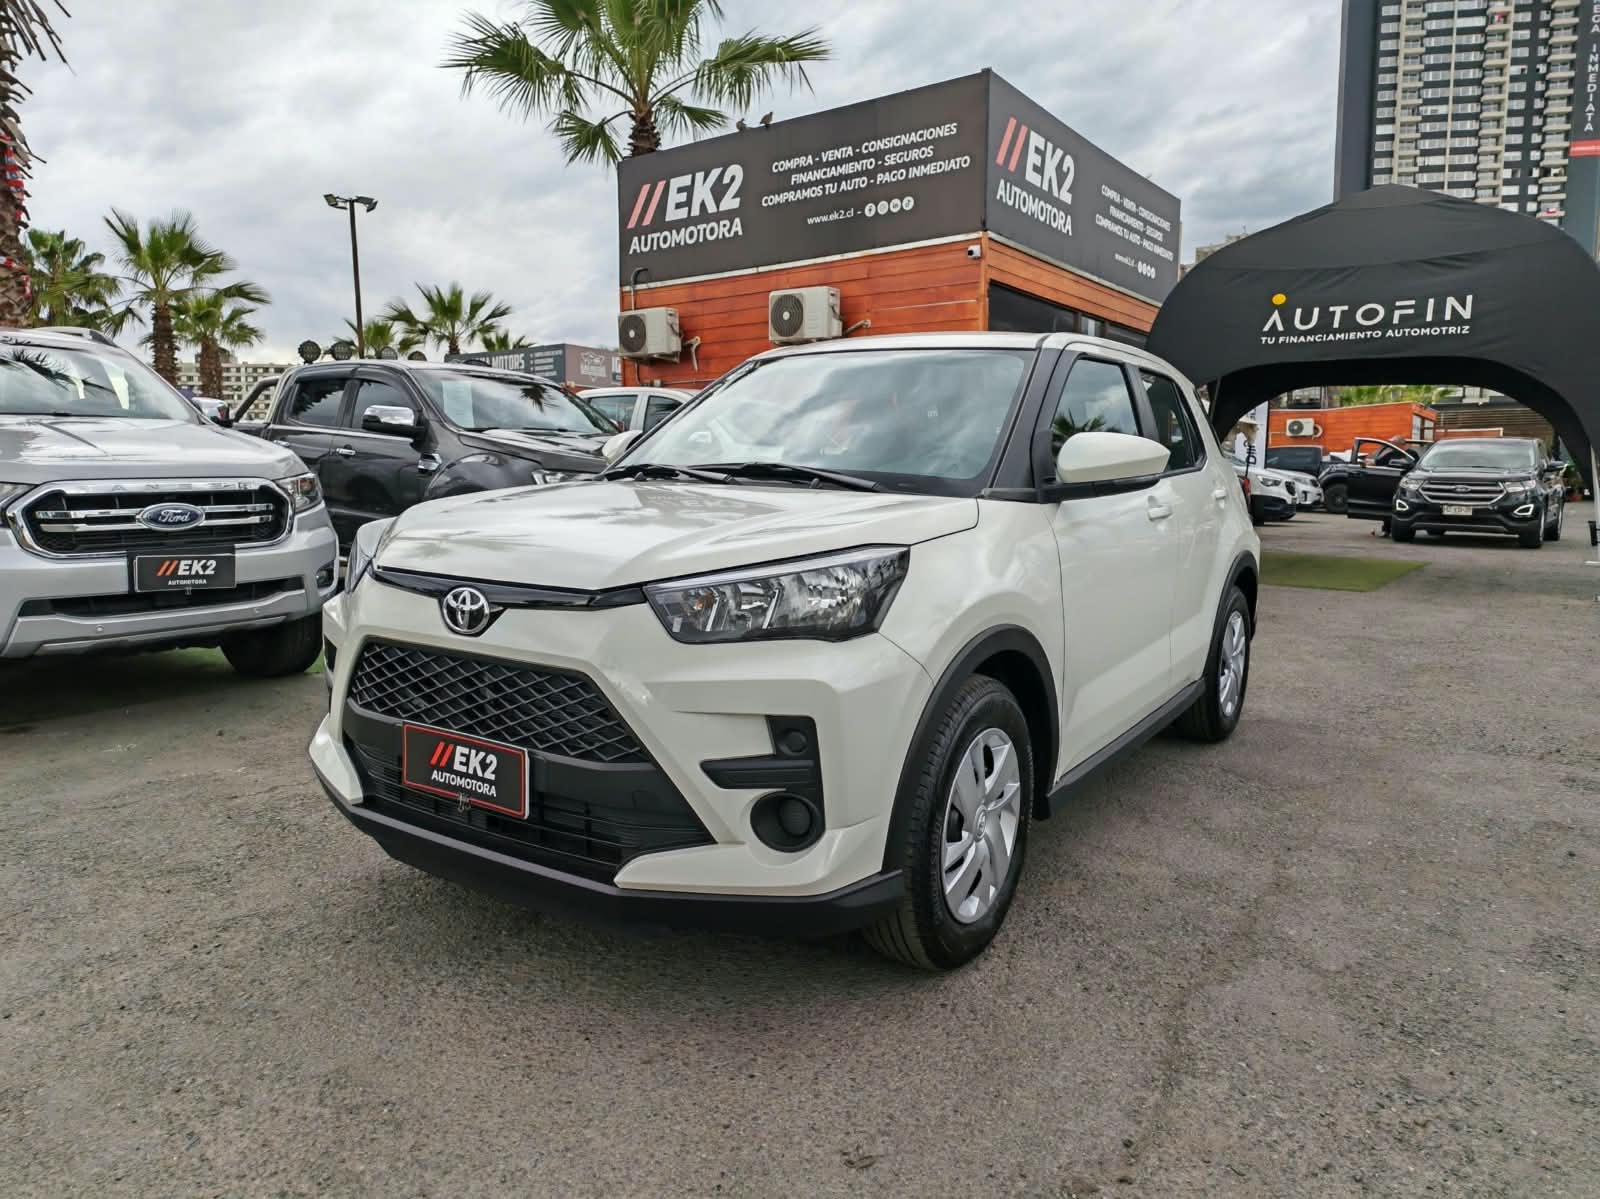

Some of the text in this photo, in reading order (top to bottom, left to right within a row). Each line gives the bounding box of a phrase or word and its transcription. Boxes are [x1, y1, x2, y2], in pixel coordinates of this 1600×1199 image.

[1584, 43, 1599, 132] INMEDIATA
[772, 155, 813, 173] COMPRA
[821, 146, 854, 163] VENTA
[861, 122, 958, 154] CONSIGNACIONES
[791, 158, 875, 185] FINANCIAMIENTO
[884, 145, 934, 166] SEGUROS
[761, 185, 823, 207] COMPRAMOS
[825, 182, 837, 195] TU
[839, 176, 868, 192] AUTO
[877, 169, 906, 184] PAGO
[908, 155, 971, 178] INMEDIATO
[807, 208, 854, 225] www.ek2.cl
[996, 178, 1072, 236] AUTOMOTORA
[629, 217, 743, 255] AUTOMOTORA
[1262, 294, 1473, 331] AUTOFIN
[1261, 325, 1470, 344] TU FINANCIAMIENTO AUTOMOTRIZ
[159, 510, 191, 522] Ford
[431, 769, 497, 797] AUTOMOTORA
